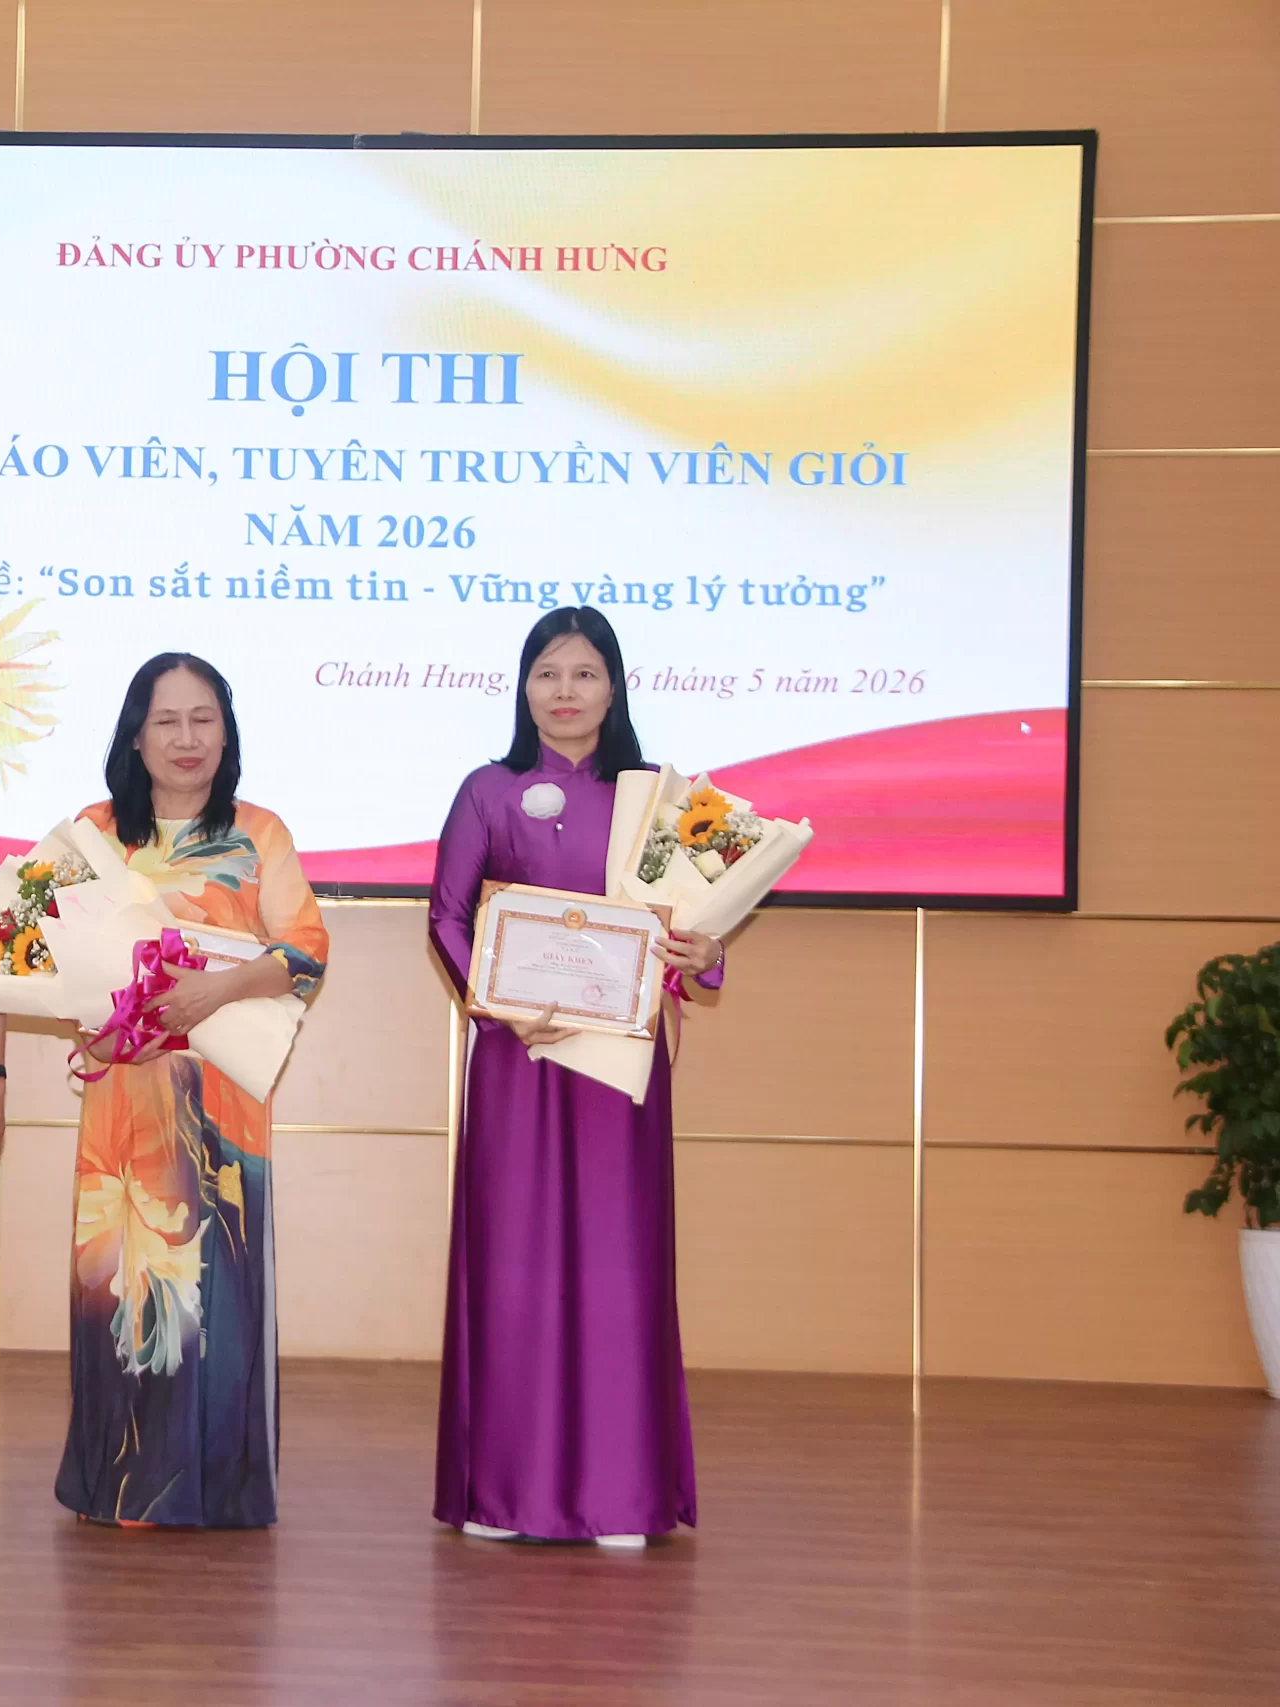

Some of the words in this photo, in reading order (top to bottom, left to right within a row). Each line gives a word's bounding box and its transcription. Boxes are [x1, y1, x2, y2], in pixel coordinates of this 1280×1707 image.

[57, 236, 162, 268] ĐẢNG
[175, 236, 225, 268] ỦY
[235, 238, 396, 271] PHƯỜNG
[408, 239, 544, 271] CHÁNH
[556, 243, 667, 271] HƯNG
[208, 342, 360, 417] HỘI
[382, 353, 525, 404] THI
[82, 436, 219, 486] VIÊN,
[232, 439, 406, 482] TUYÊN
[420, 441, 632, 484] TRUYỀN
[647, 441, 776, 485] VIÊN
[789, 442, 908, 486] GIỎI
[245, 504, 362, 547] NĂM
[377, 515, 475, 549] 2026
[39, 566, 134, 597] “Son
[150, 561, 211, 598] sắt
[226, 563, 333, 600] niềm
[346, 570, 408, 601] tin
[448, 573, 560, 610] Vững
[571, 574, 674, 611] vàng
[687, 575, 727, 612] lý
[739, 575, 886, 613] tưởng”
[315, 662, 409, 687] Chánh
[422, 664, 509, 695] Hưng,
[651, 667, 736, 699] tháng
[748, 668, 764, 692] 5
[776, 670, 838, 692] năm
[850, 669, 924, 694] 2026
